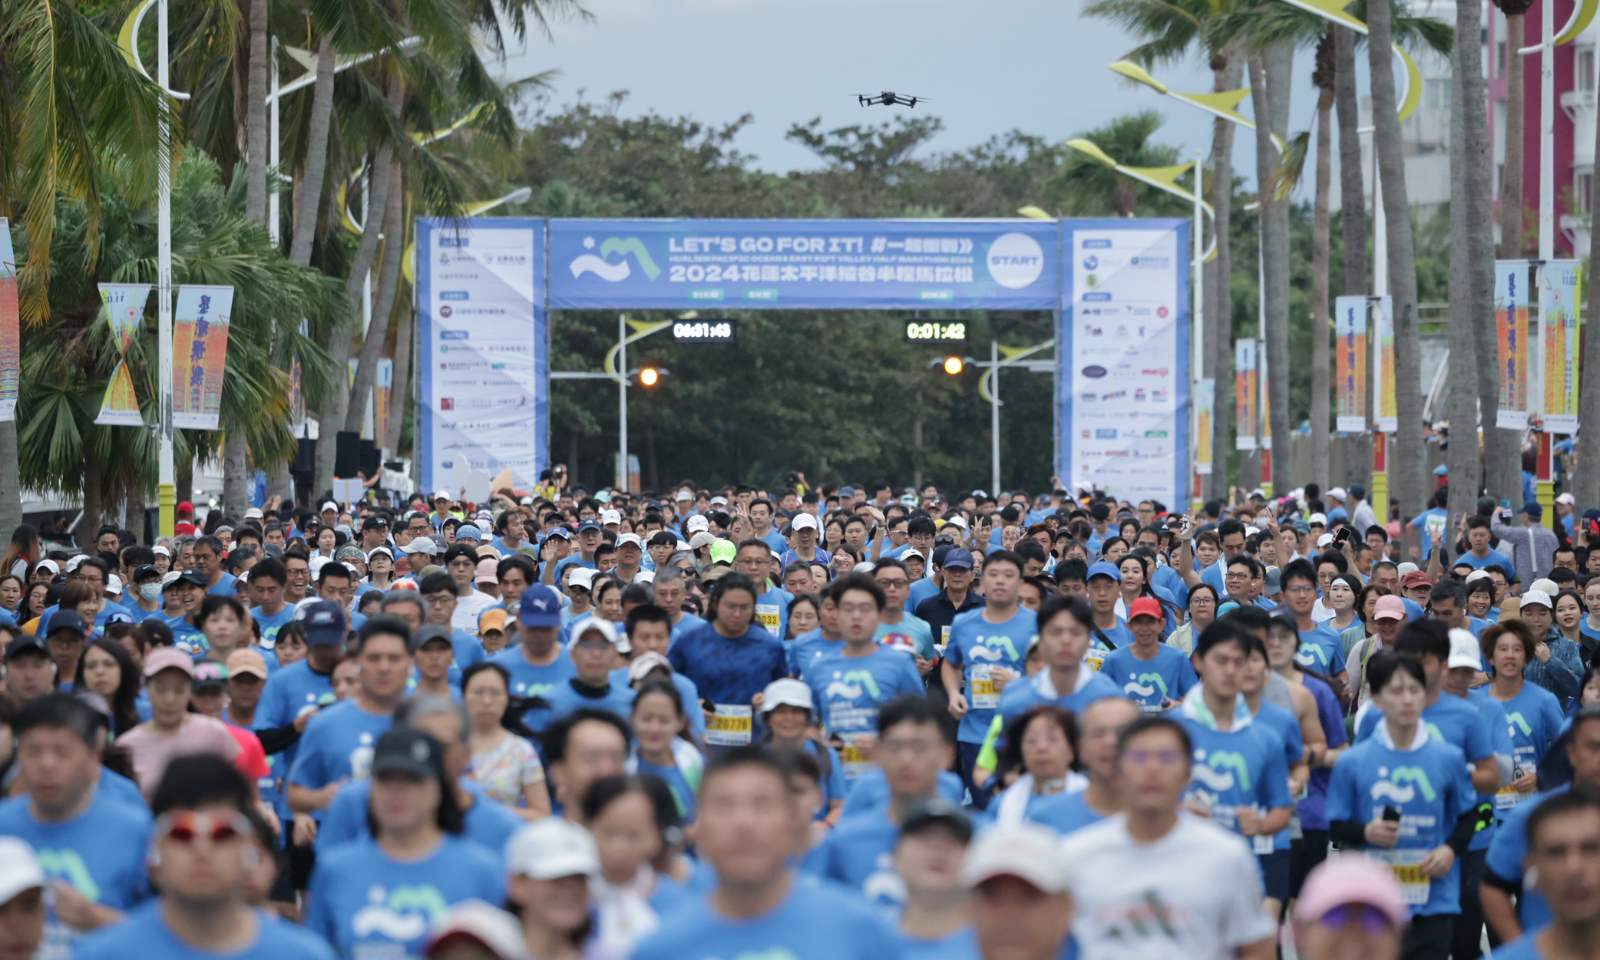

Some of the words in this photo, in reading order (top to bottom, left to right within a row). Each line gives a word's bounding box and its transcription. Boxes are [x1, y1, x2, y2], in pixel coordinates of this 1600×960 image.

[669, 237, 737, 253] LET'S
[740, 237, 774, 253] GO
[777, 237, 825, 253] FOR
[829, 237, 864, 253] IT!
[991, 255, 1040, 266] START
[907, 322, 965, 340] 0:01:42
